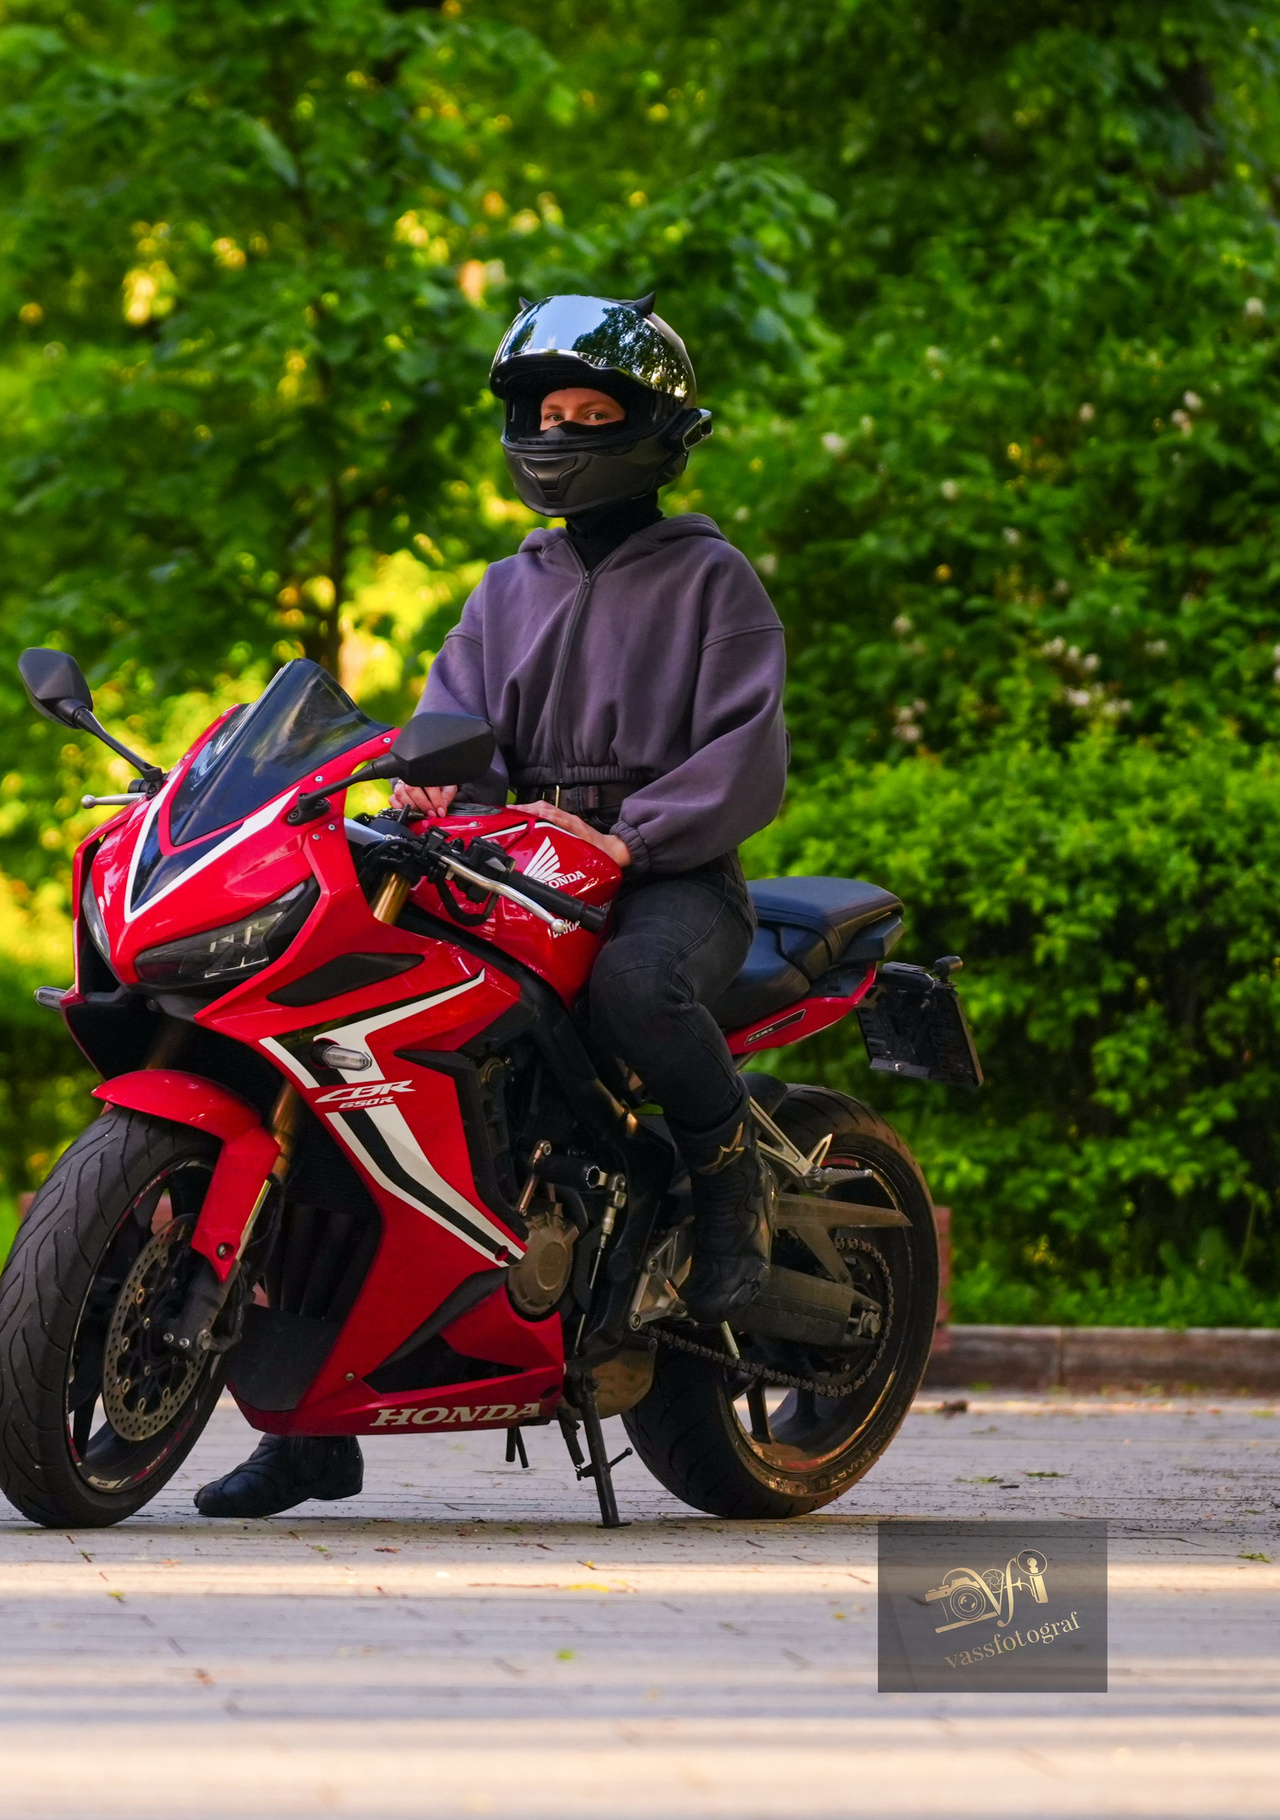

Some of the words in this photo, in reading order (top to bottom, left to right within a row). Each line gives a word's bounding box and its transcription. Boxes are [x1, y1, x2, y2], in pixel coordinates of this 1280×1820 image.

[547, 870, 587, 889] ONDA
[315, 1080, 416, 1103] CBR
[338, 1096, 394, 1109] 650R
[370, 1403, 540, 1426] HONDA
